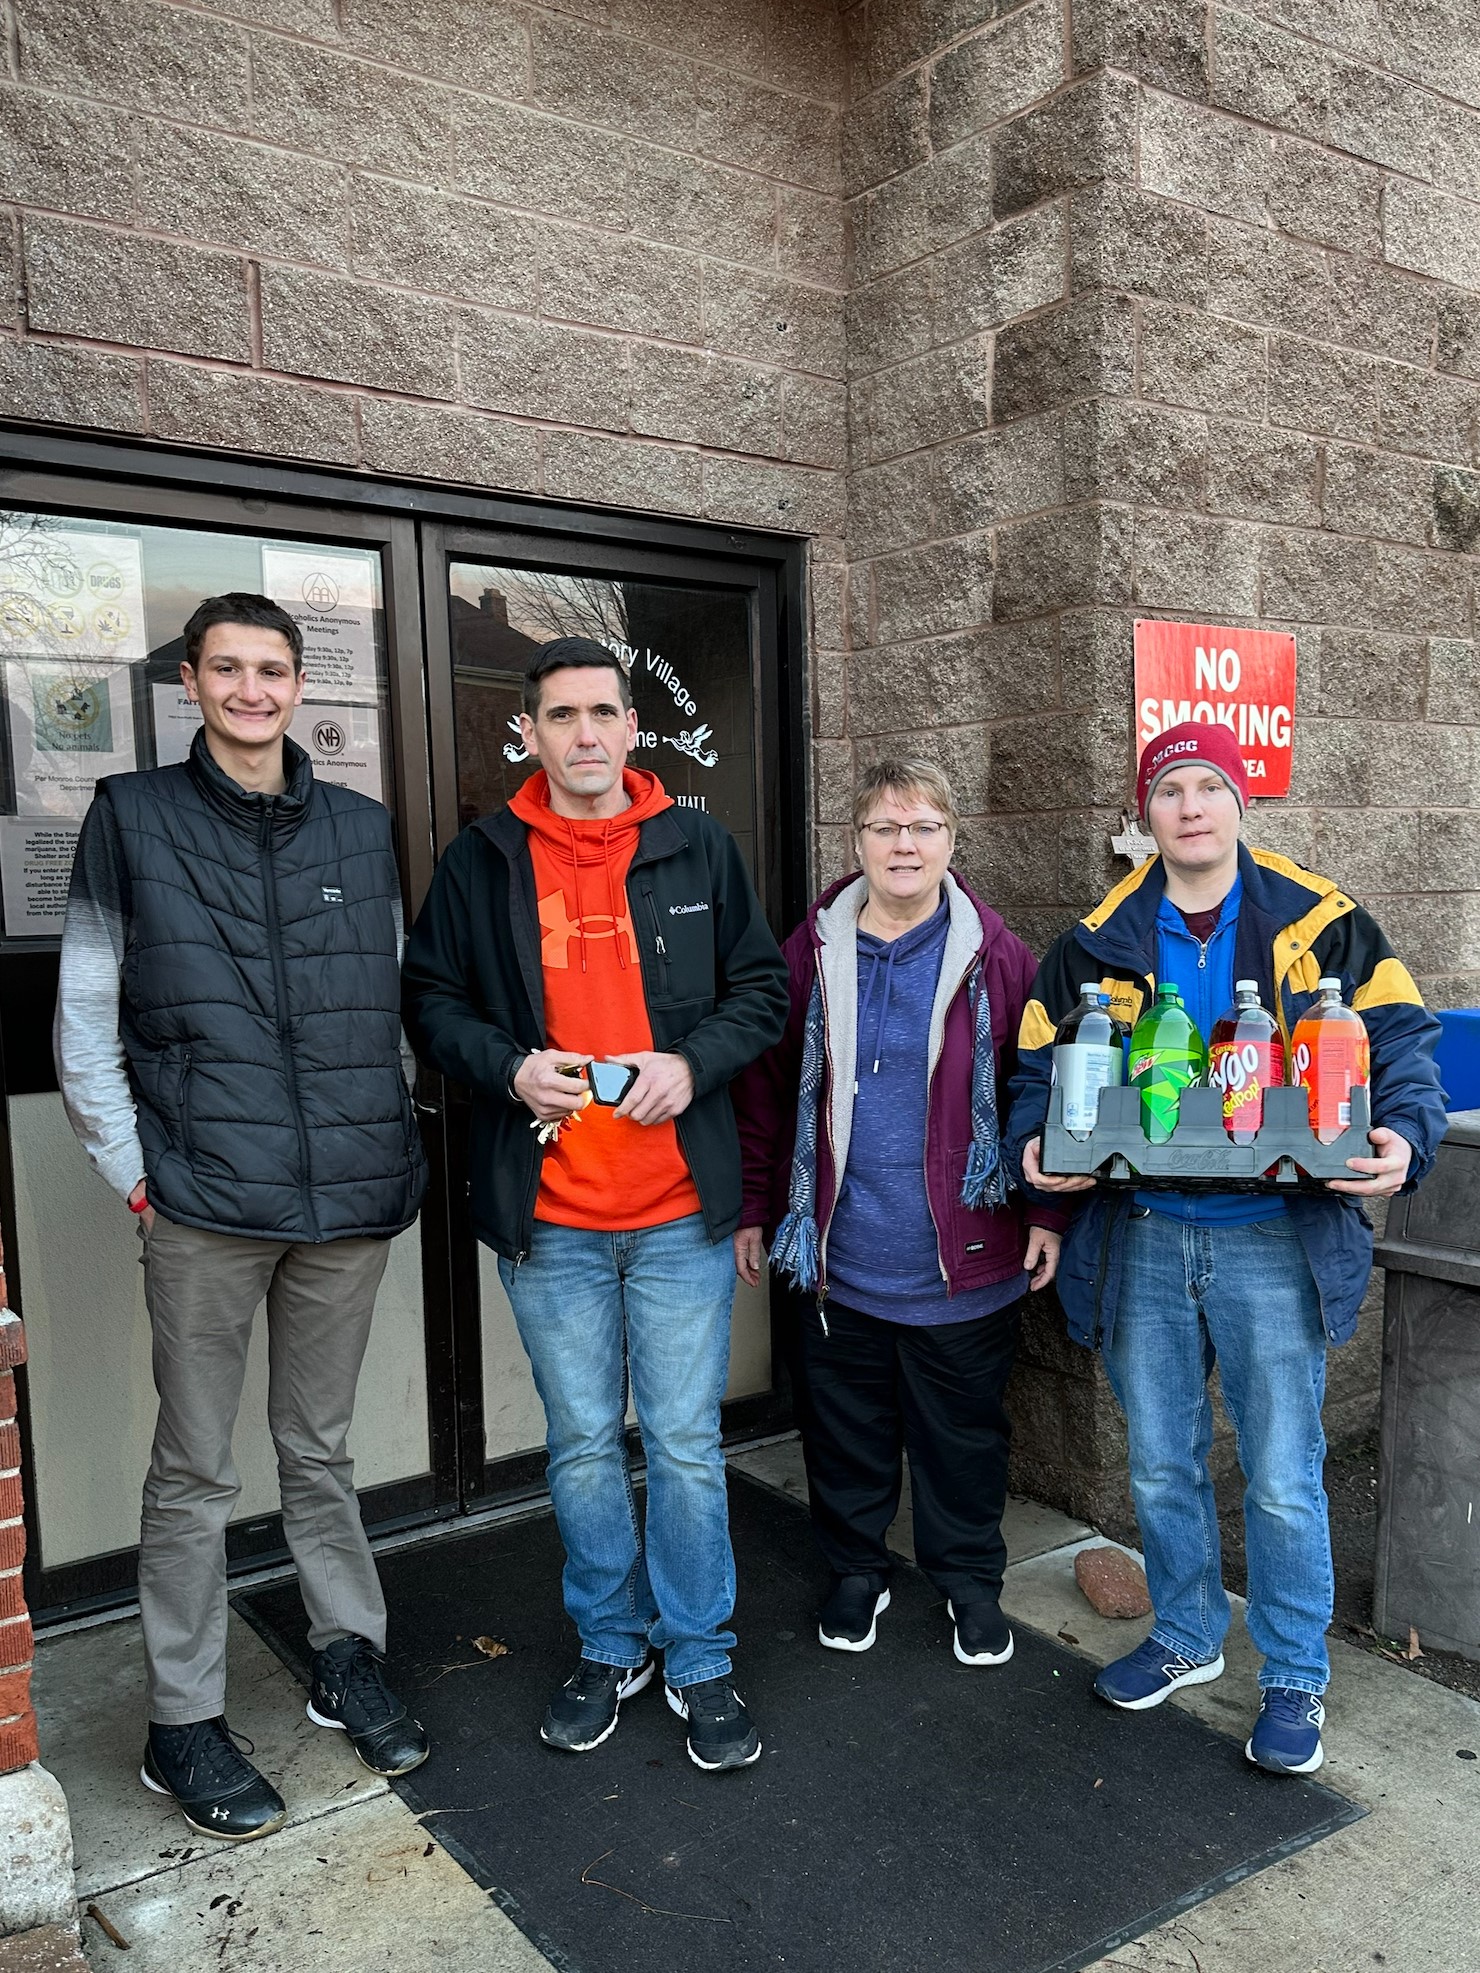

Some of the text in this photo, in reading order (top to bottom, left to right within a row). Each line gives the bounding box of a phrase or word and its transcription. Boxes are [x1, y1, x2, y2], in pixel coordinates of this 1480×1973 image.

[319, 616, 361, 626] Anonymous
[306, 626, 340, 636] Meetings
[303, 653, 322, 662] uesday
[1195, 646, 1241, 693] NO
[646, 648, 697, 716] Village
[1140, 697, 1292, 748] SMOKING
[59, 731, 92, 742] No pets
[52, 742, 100, 751] No animals
[326, 759, 367, 768] Anonymous
[1243, 759, 1267, 778] EA
[60, 784, 96, 792] Departmen
[674, 901, 710, 915] Columbia
